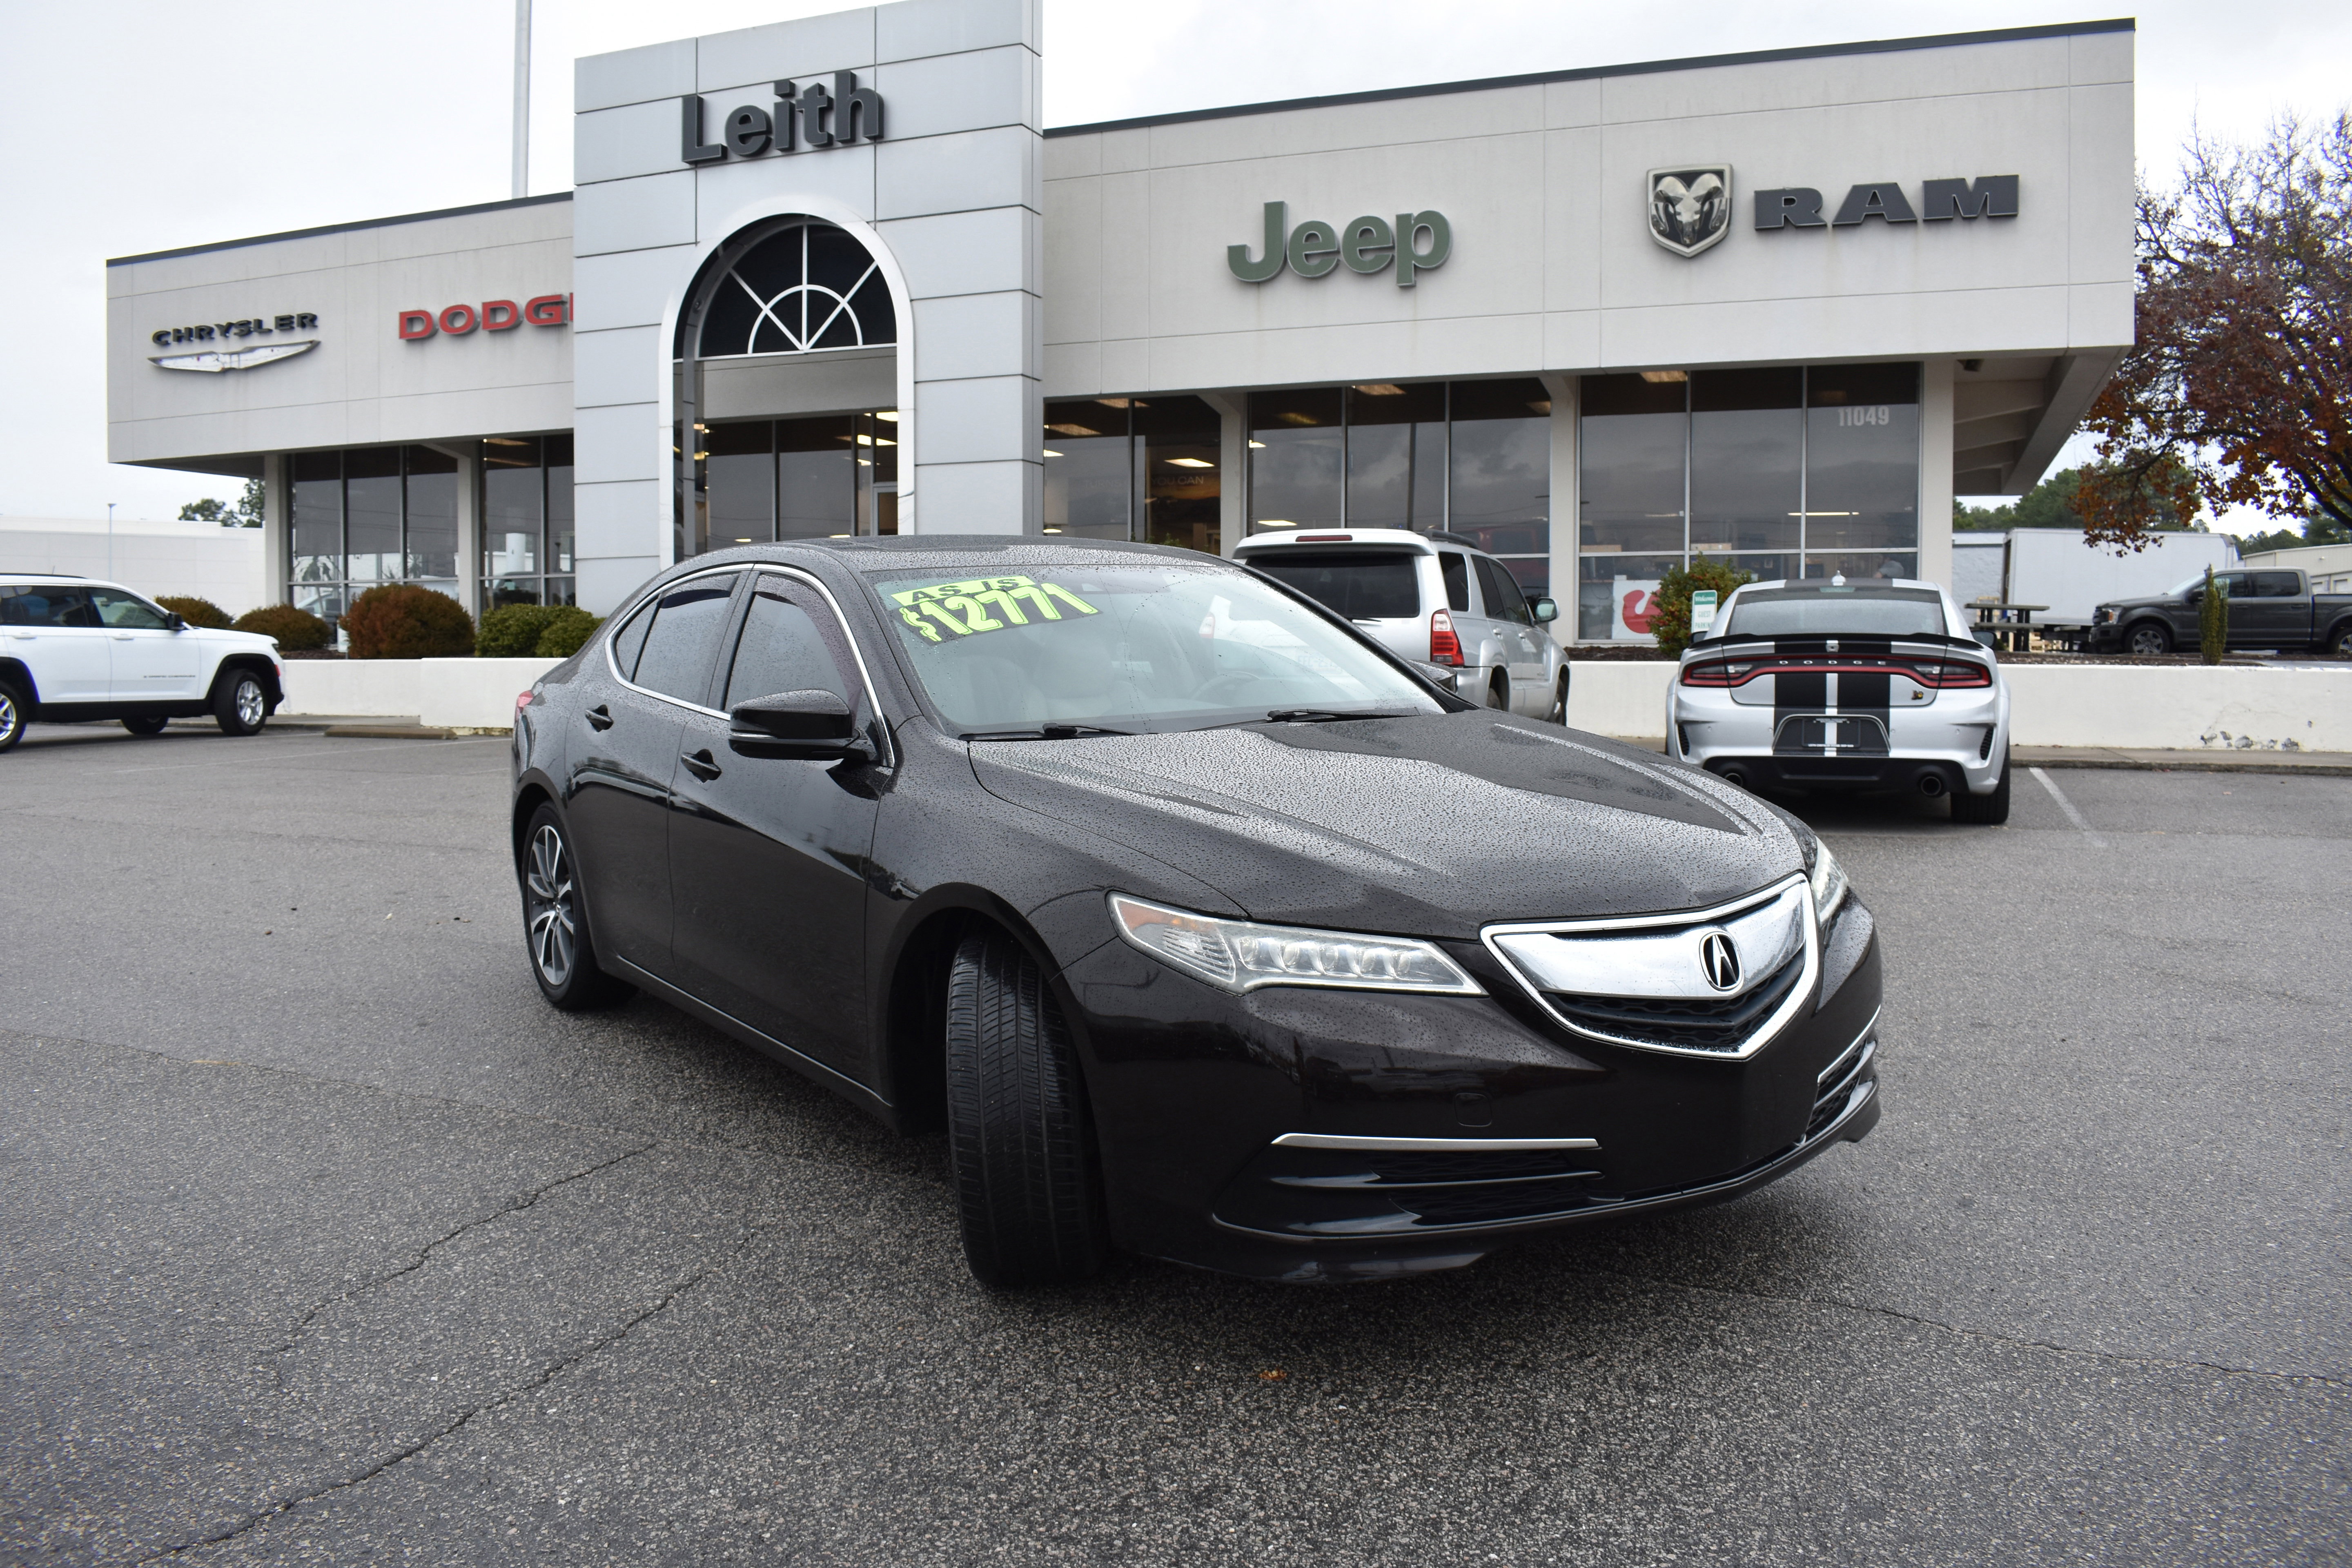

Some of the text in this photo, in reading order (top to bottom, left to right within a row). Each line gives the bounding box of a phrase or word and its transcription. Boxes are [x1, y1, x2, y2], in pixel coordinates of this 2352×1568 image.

[682, 70, 884, 165] Leith
[1754, 174, 2019, 231] RAM
[1227, 201, 1452, 287] Jeep
[152, 312, 318, 346] CHRYSLER
[399, 292, 573, 339] DODG
[1838, 405, 1889, 426] 11049
[1177, 476, 1204, 484] CAN
[899, 583, 1098, 641] $12771
[912, 579, 1020, 603] AS IS
